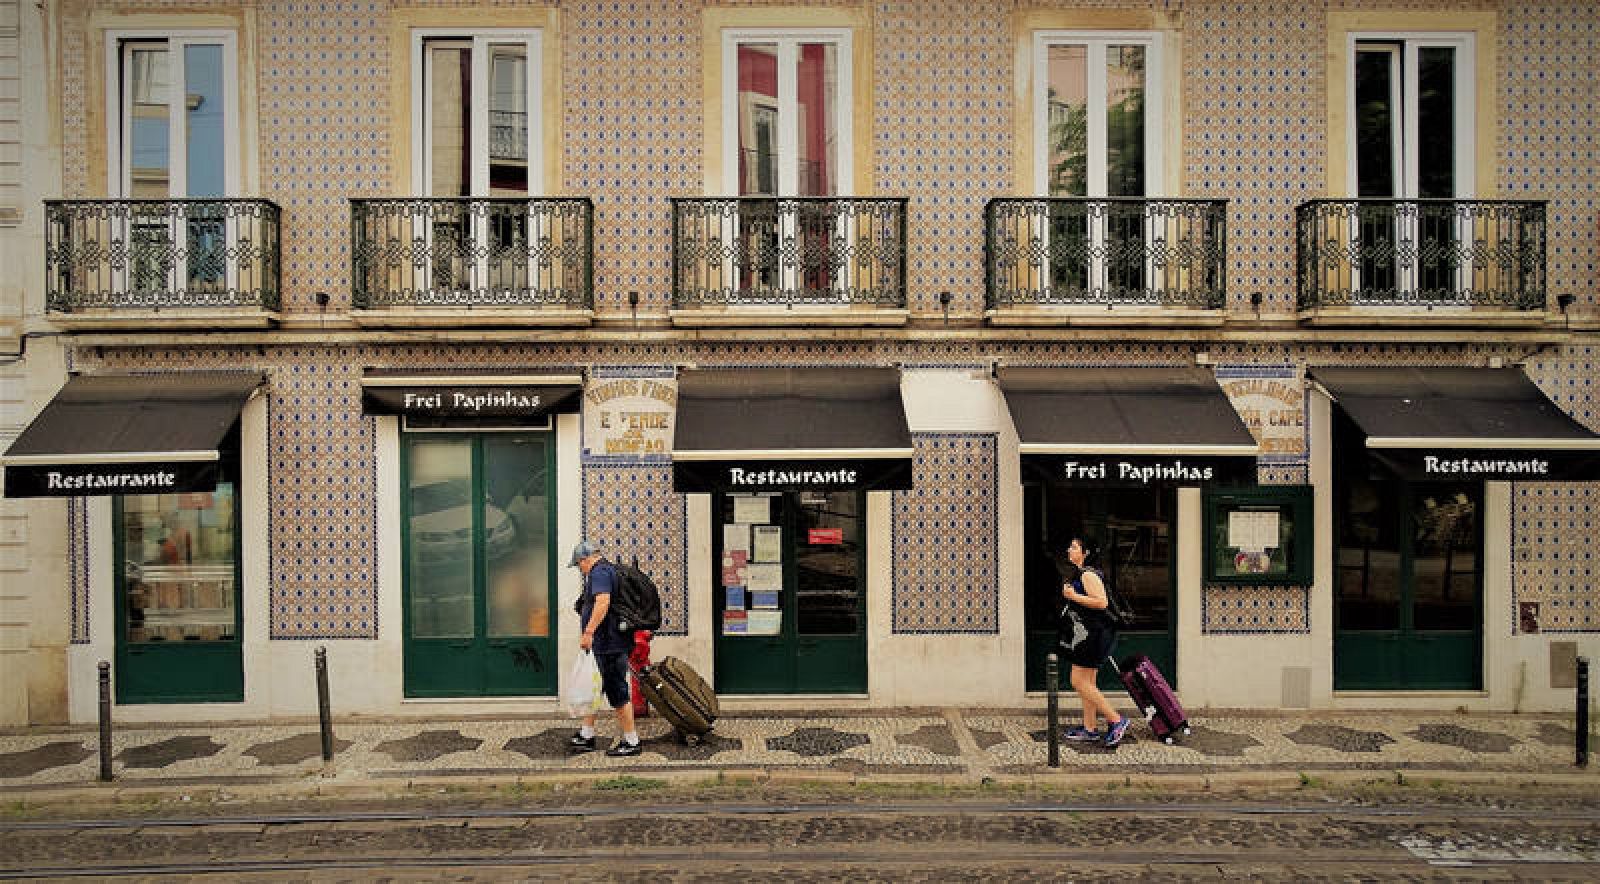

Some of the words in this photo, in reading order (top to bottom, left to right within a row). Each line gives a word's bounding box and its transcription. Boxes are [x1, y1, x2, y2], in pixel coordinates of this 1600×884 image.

[403, 393, 441, 408] Frei
[453, 390, 541, 411] Papinhas
[1064, 461, 1106, 479] Frei
[1117, 459, 1214, 484] Papinhas
[1423, 455, 1549, 474] Restaurante
[47, 471, 175, 489] Restaurante
[728, 466, 857, 485] Restaurante
